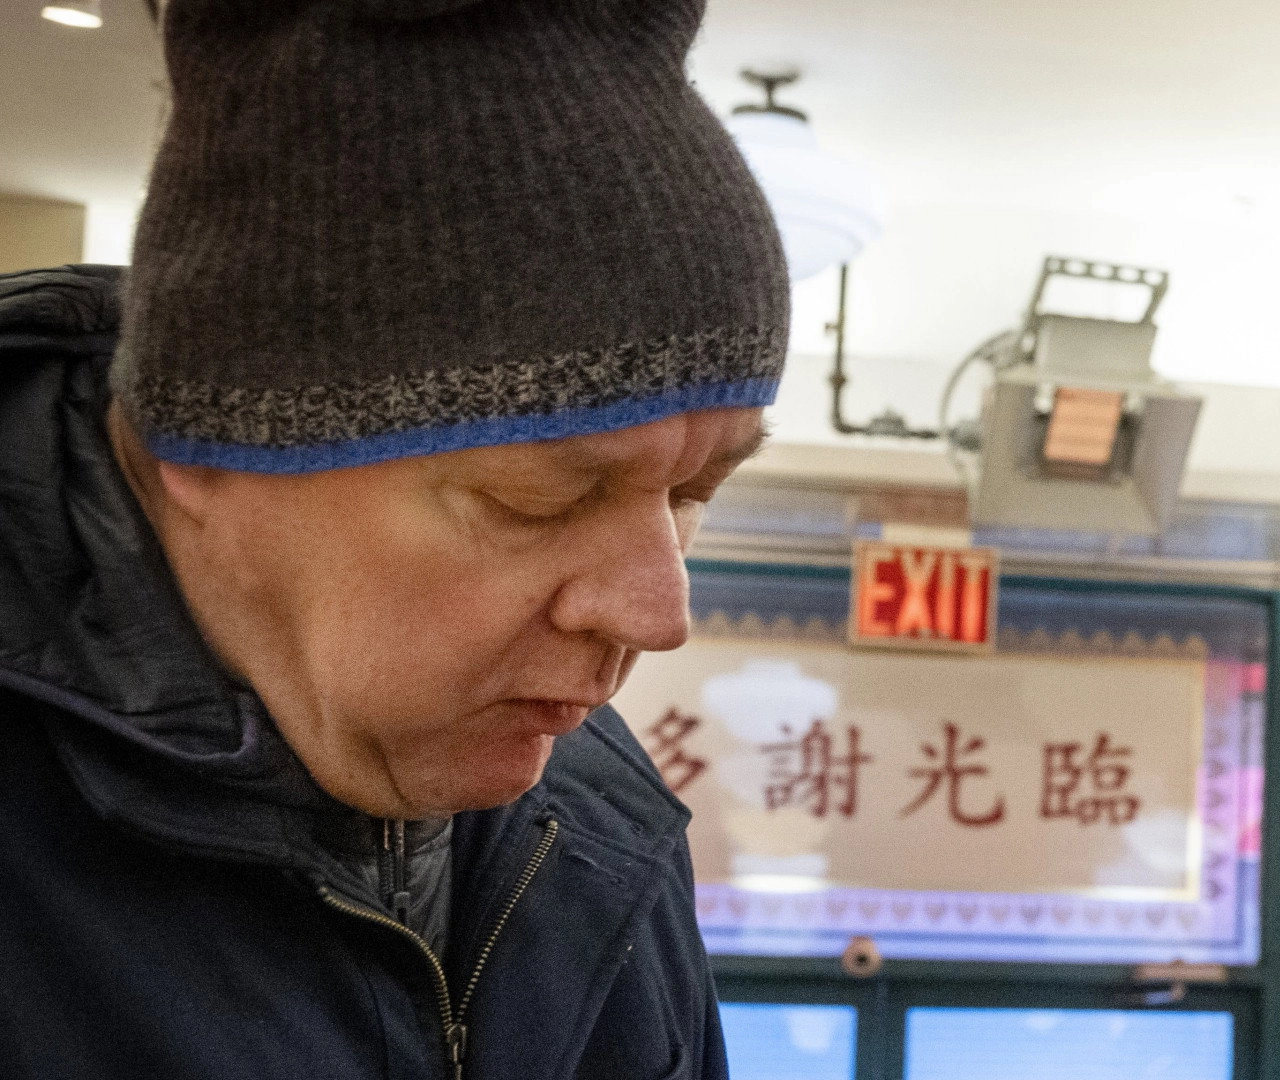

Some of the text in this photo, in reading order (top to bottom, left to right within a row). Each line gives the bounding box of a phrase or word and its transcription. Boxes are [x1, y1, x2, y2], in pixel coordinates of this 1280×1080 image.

[857, 548, 989, 643] EXIT
[646, 706, 1141, 828] 多謝光臨
